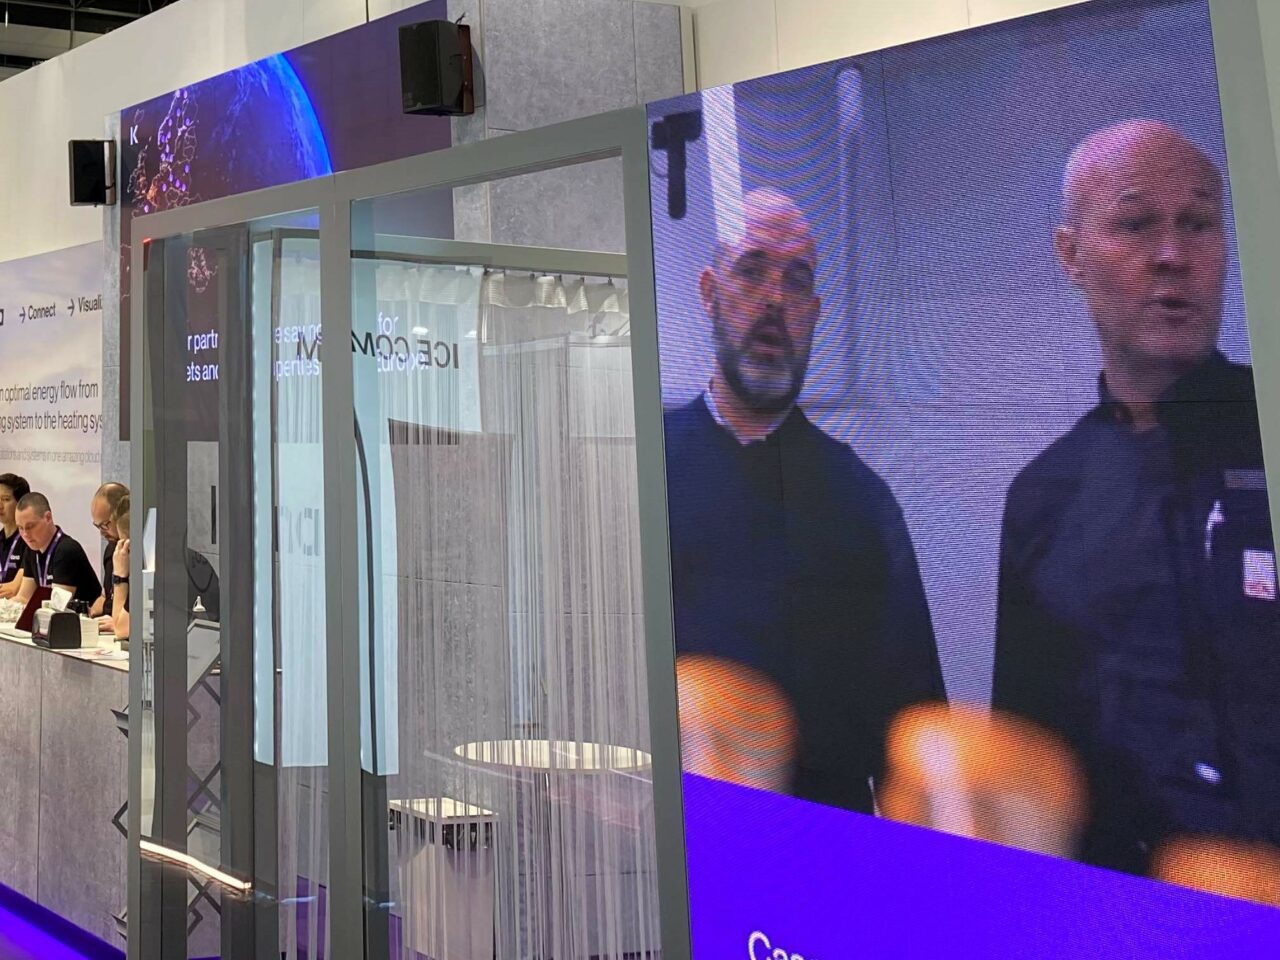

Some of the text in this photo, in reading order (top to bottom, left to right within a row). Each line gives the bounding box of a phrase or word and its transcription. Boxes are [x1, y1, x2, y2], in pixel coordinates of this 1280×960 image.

[27, 302, 57, 321] Connect
[78, 293, 102, 314] Visuali
[5, 382, 31, 404] optimal
[32, 385, 59, 404] energy
[60, 380, 78, 399] flow
[79, 378, 99, 399] from
[7, 412, 33, 433] system
[35, 411, 43, 430] to
[43, 411, 57, 430] the
[58, 410, 89, 433] heating
